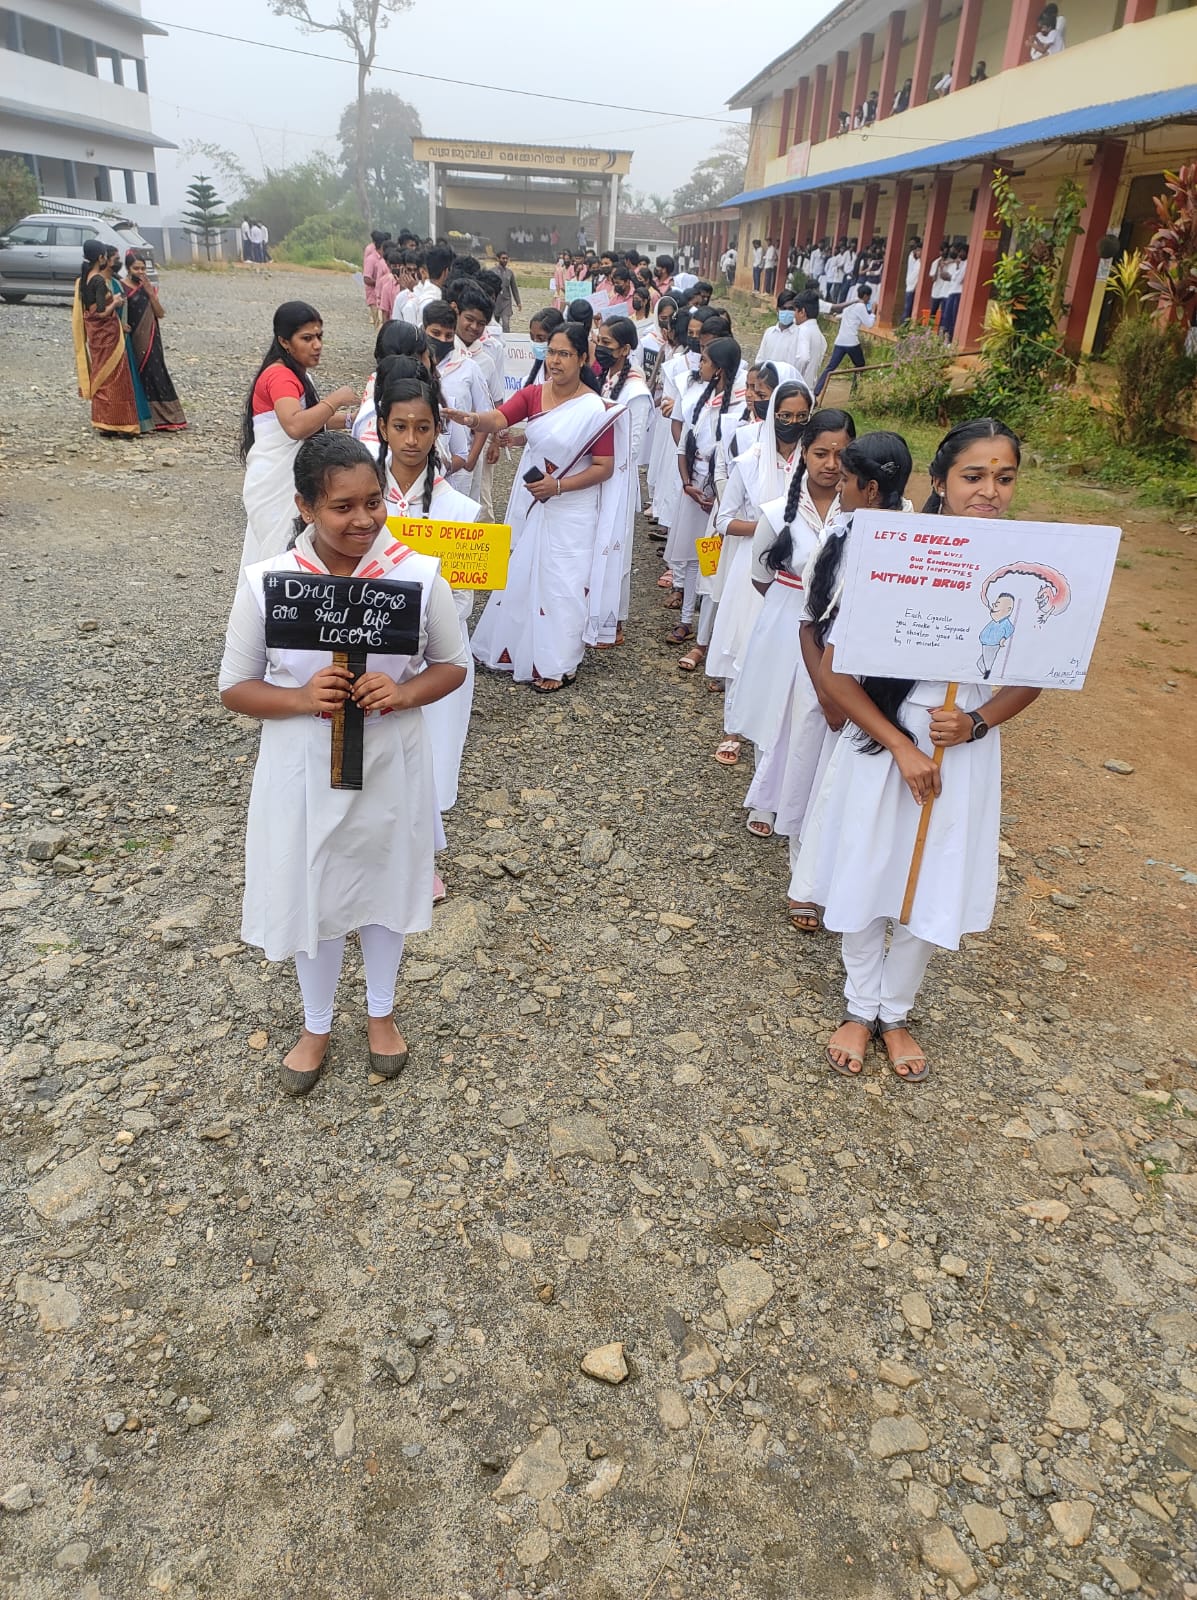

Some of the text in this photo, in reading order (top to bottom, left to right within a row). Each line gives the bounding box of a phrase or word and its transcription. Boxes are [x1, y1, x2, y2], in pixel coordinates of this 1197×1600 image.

[402, 524, 484, 540] LET'S DEVELOP
[874, 531, 970, 546] LET'S DEVELOP
[470, 543, 490, 552] LIVES
[450, 570, 488, 584] DRUGS
[870, 570, 972, 591] WITHOUT DRUGS
[348, 582, 406, 610] Users
[272, 604, 298, 620] are
[362, 608, 391, 631] life
[905, 608, 922, 619] Each
